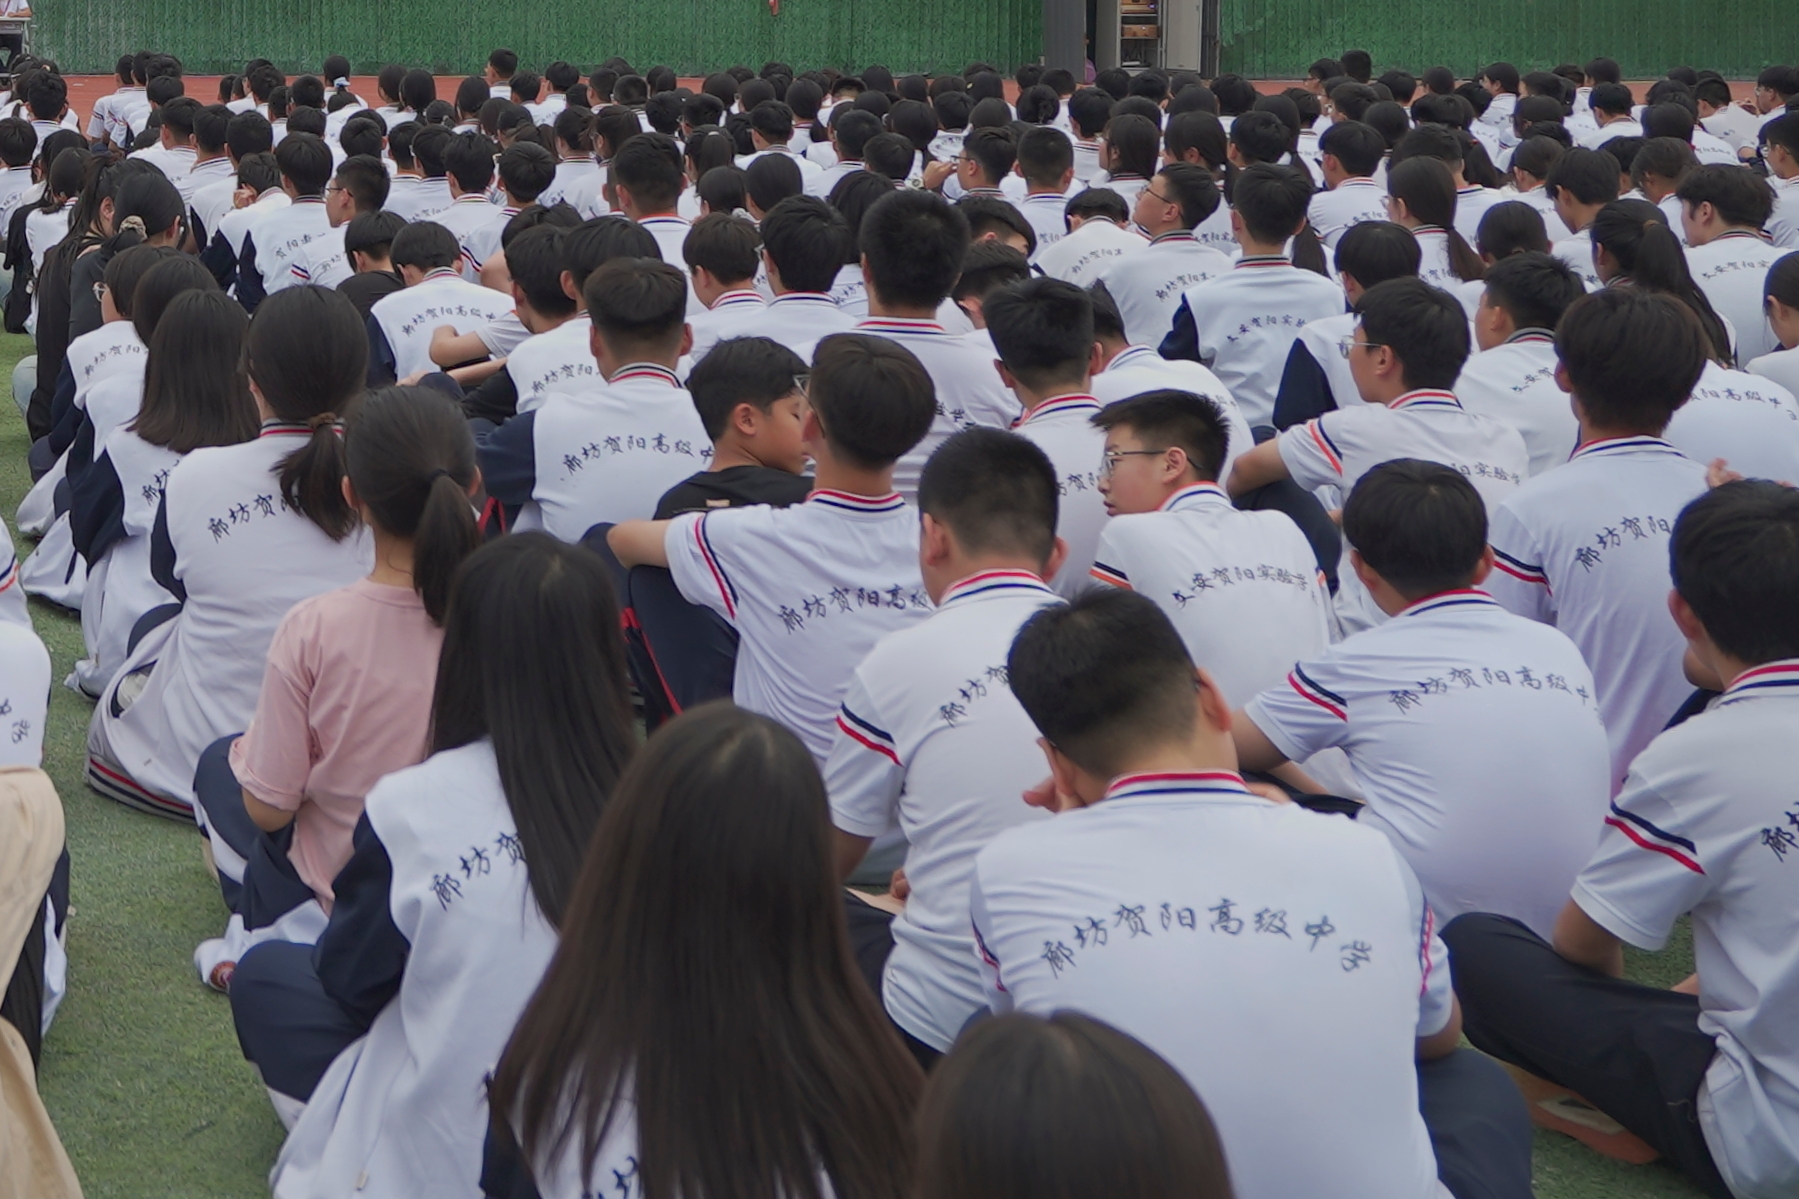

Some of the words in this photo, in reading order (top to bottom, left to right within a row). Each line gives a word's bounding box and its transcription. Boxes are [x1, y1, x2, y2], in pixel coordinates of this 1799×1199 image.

[531, 362, 605, 398] 廊坊贺阳
[1039, 896, 1376, 980] 廊坊贺阳高级中学
